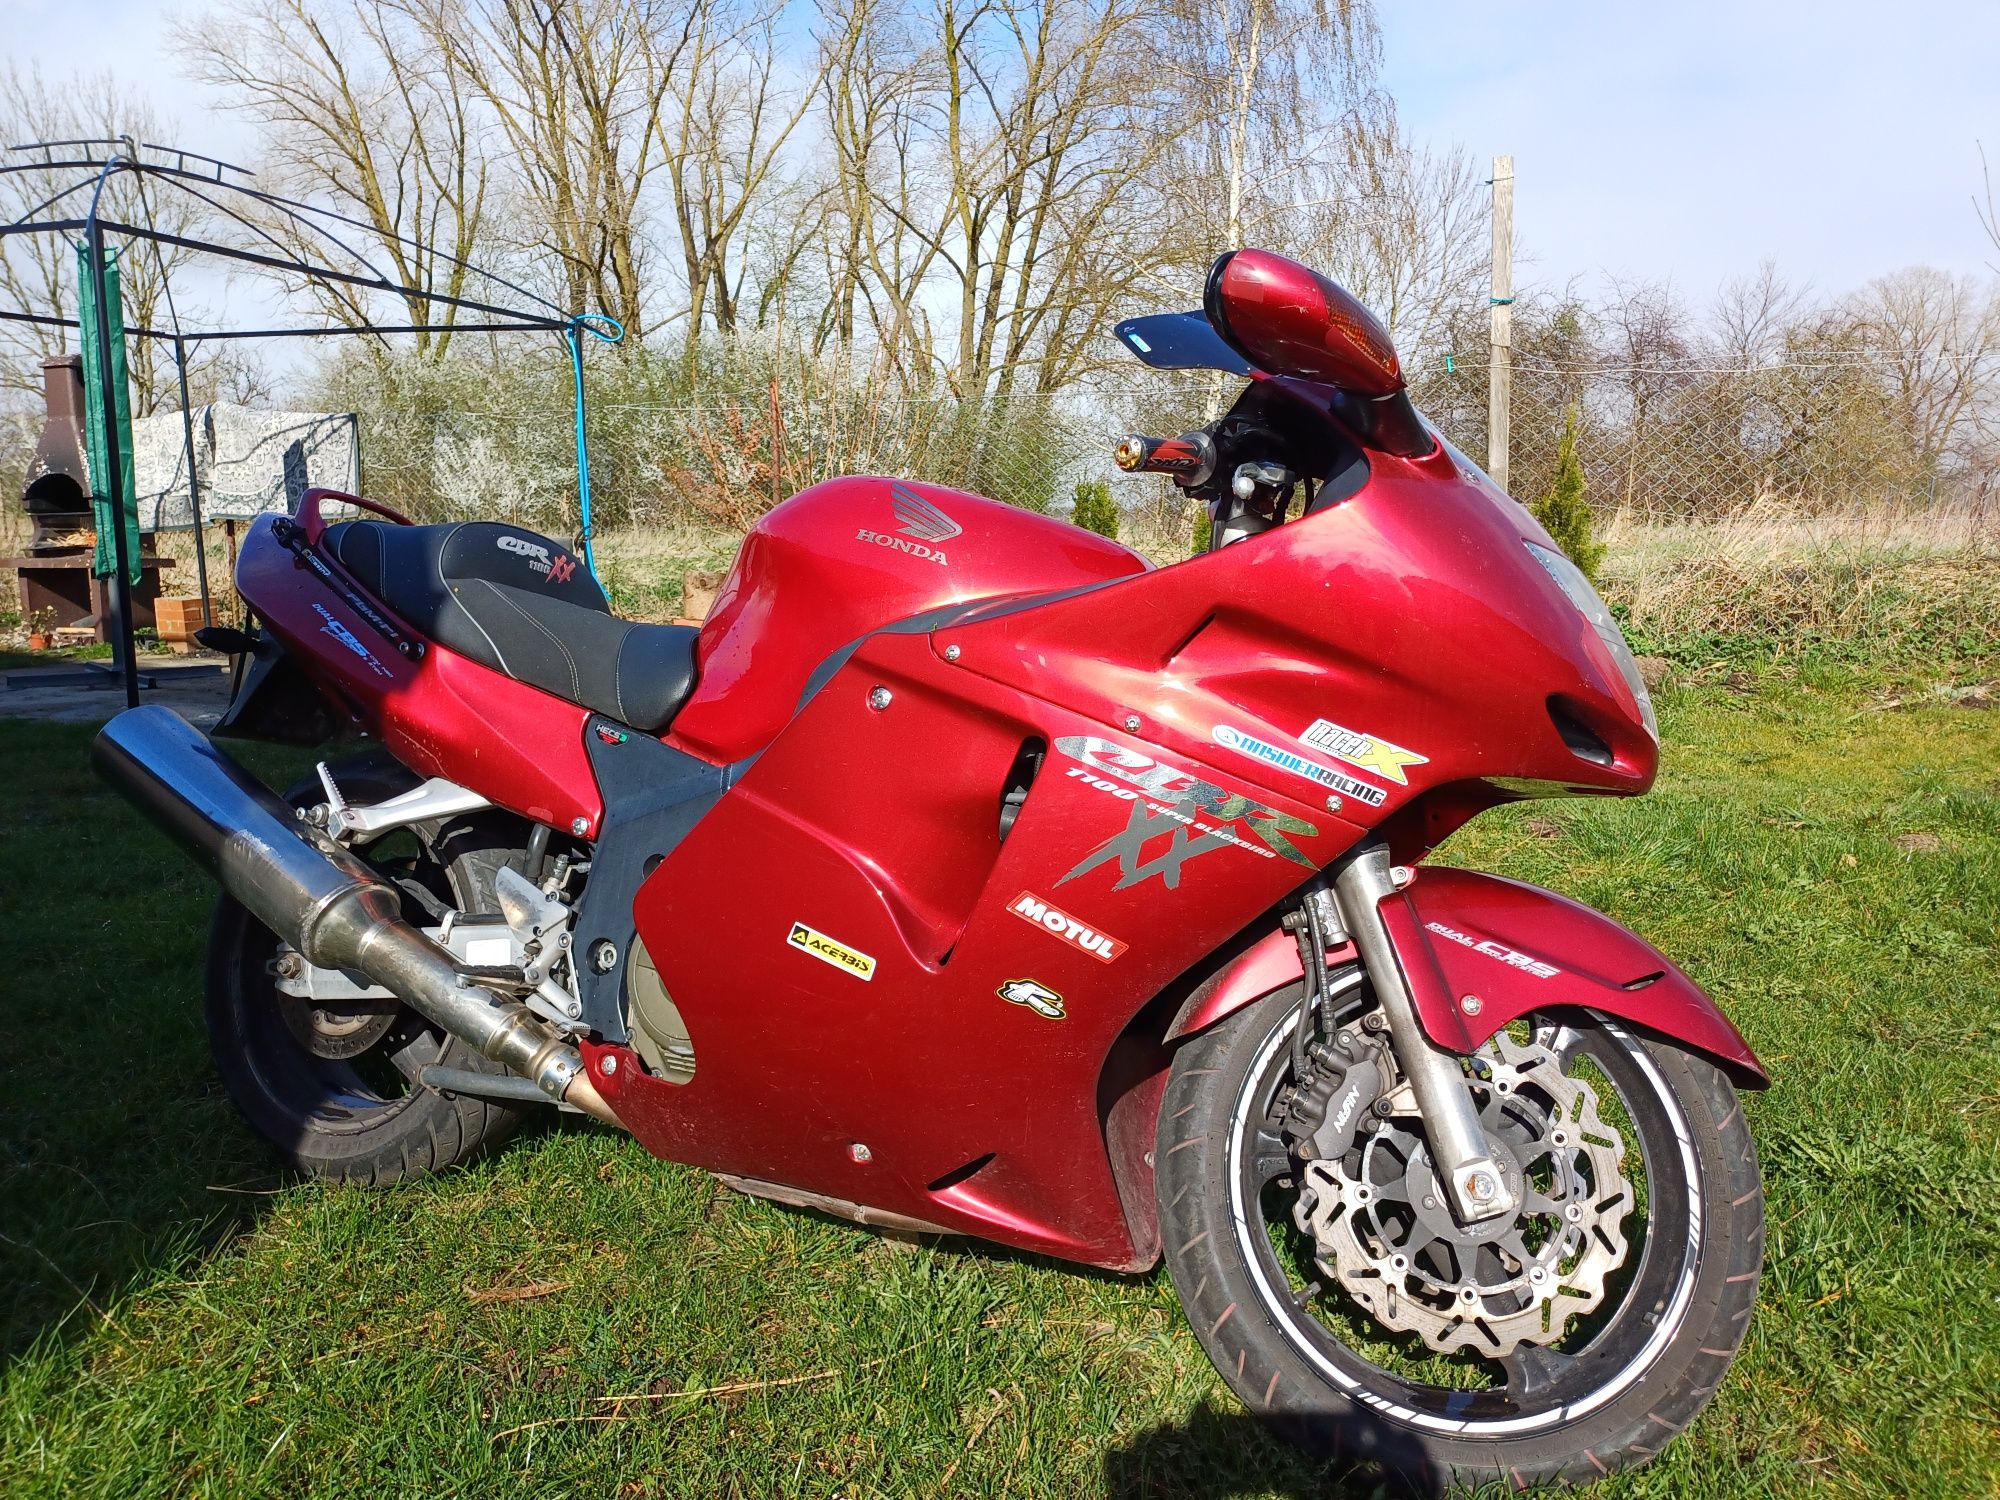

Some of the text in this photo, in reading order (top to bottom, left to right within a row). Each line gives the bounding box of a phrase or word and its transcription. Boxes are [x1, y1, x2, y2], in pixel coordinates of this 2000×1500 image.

[496, 536, 554, 567] CBR
[855, 528, 949, 566] HONDA
[311, 602, 334, 622] DUAL
[327, 620, 371, 657] CBS
[1053, 735, 1322, 872] CBR
[1065, 767, 1140, 800] 1100
[1146, 802, 1277, 859] SUPER BLACKBIRD
[1014, 896, 1114, 959] MOTUL
[1425, 921, 1475, 944] DUAL
[1472, 940, 1561, 977] CBS
